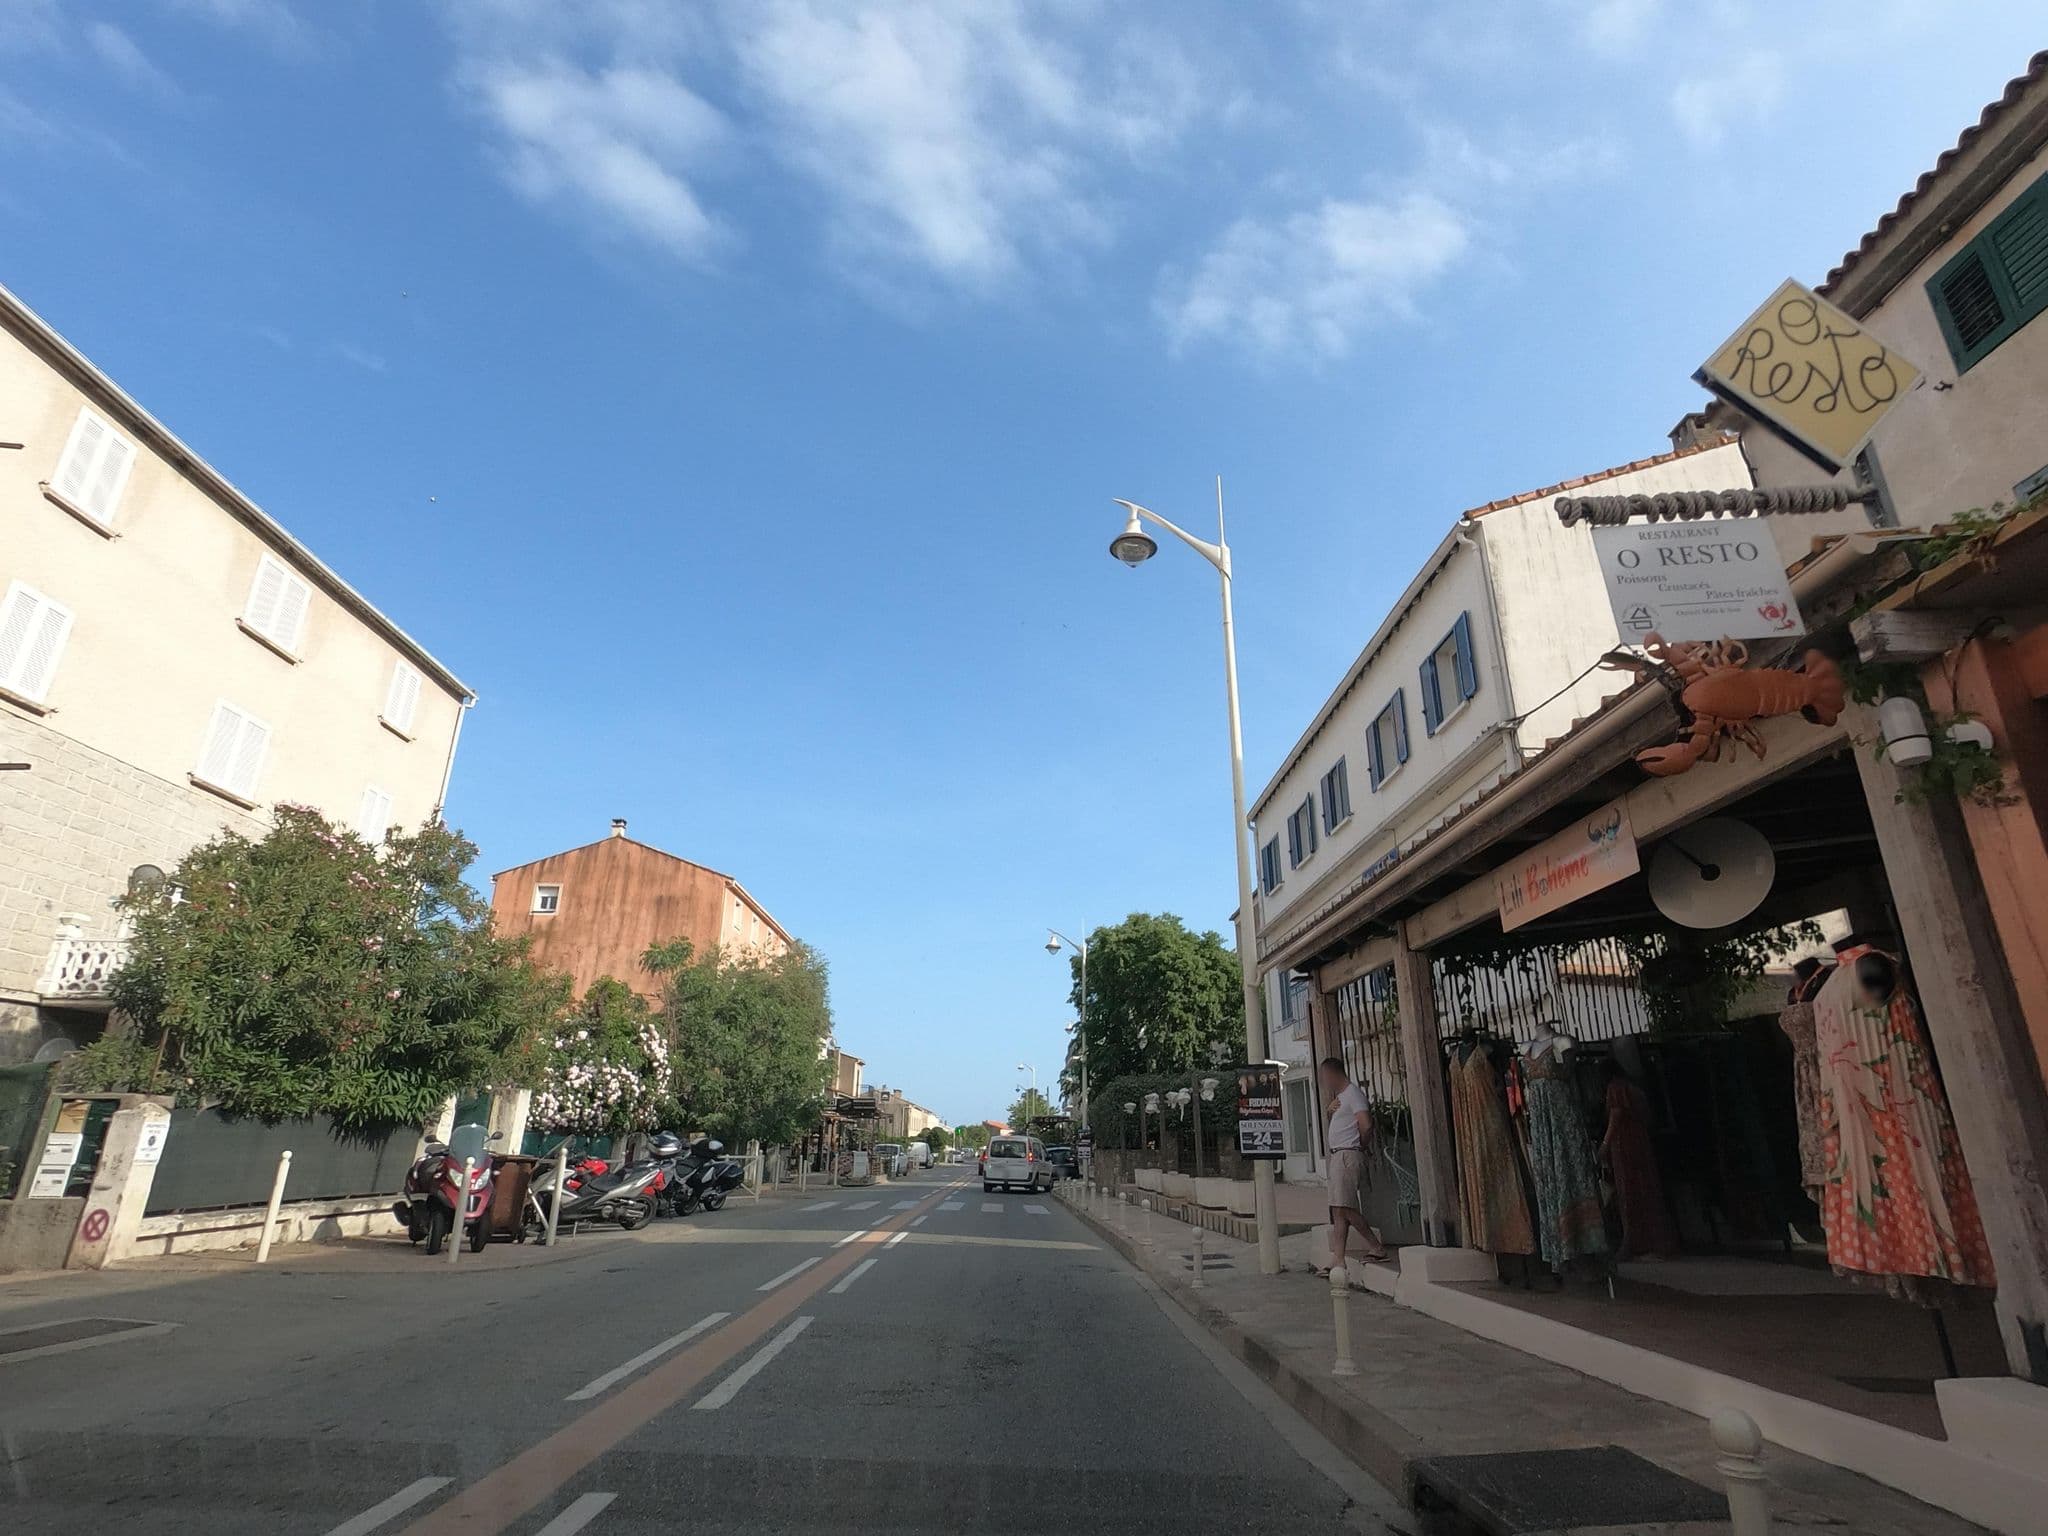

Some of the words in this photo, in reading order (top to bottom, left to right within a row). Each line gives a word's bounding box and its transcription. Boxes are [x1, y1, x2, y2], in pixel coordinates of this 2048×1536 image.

[1778, 296, 1820, 346] O
[1730, 325, 1897, 413] Resto
[1638, 527, 1721, 541] RESTAURANT
[1617, 549, 1640, 568] O
[1659, 542, 1759, 566] RESTO
[1616, 573, 1667, 585] Poissons
[1501, 874, 1524, 915] Lili
[1253, 1132, 1273, 1145] 24
